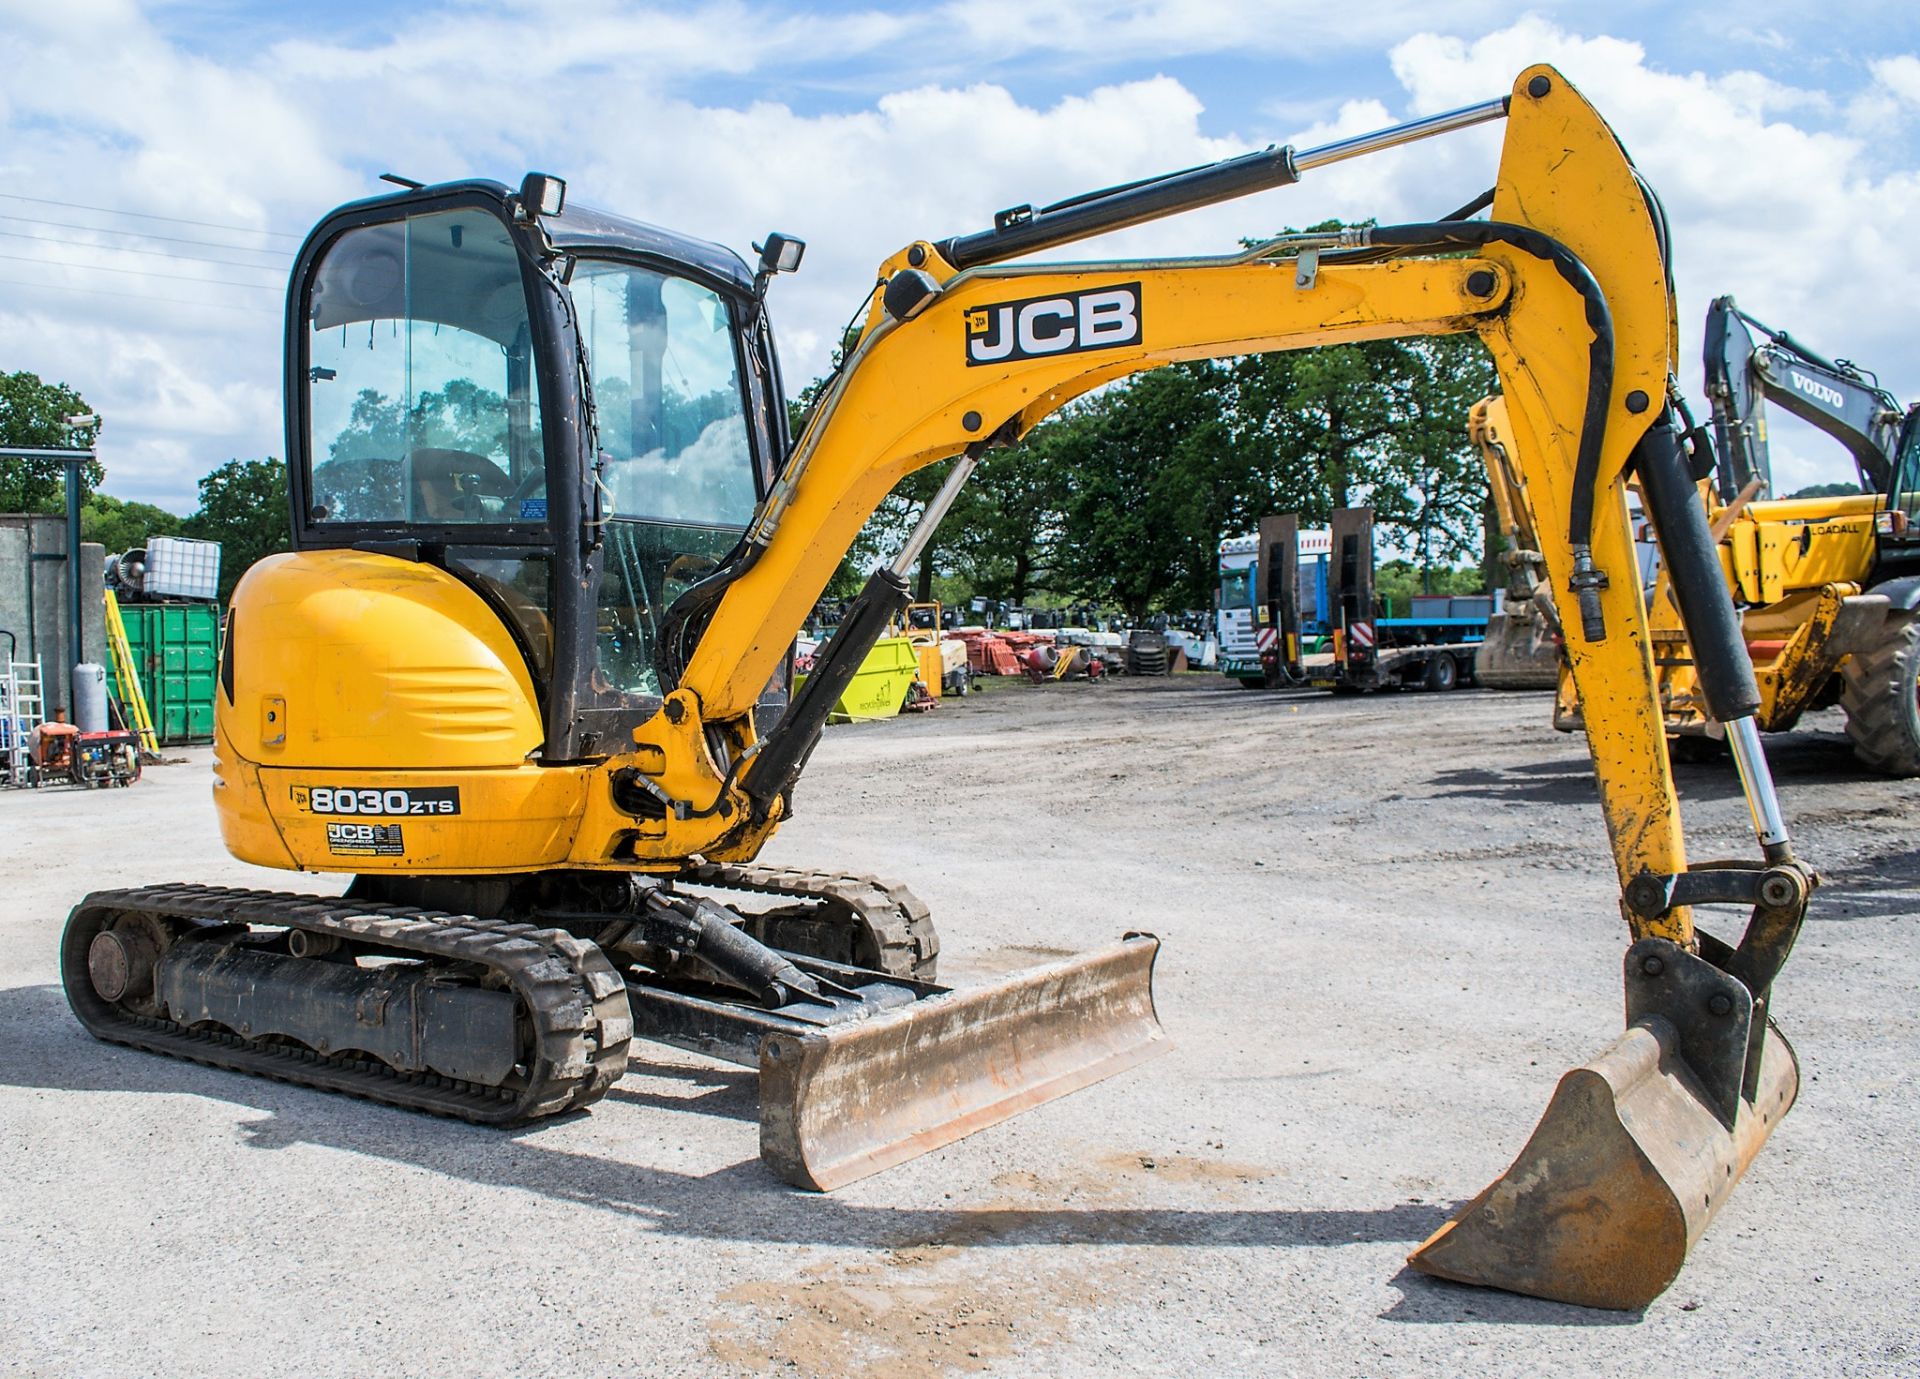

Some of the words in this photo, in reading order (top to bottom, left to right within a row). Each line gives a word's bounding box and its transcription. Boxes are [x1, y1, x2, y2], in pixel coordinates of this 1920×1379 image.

[971, 289, 1137, 361] JCB
[1790, 370, 1844, 409] VOLVO
[1812, 524, 1860, 536] LOADALL
[311, 788, 409, 814] 8030
[409, 800, 454, 813] ZTS
[329, 825, 375, 839] JCB
